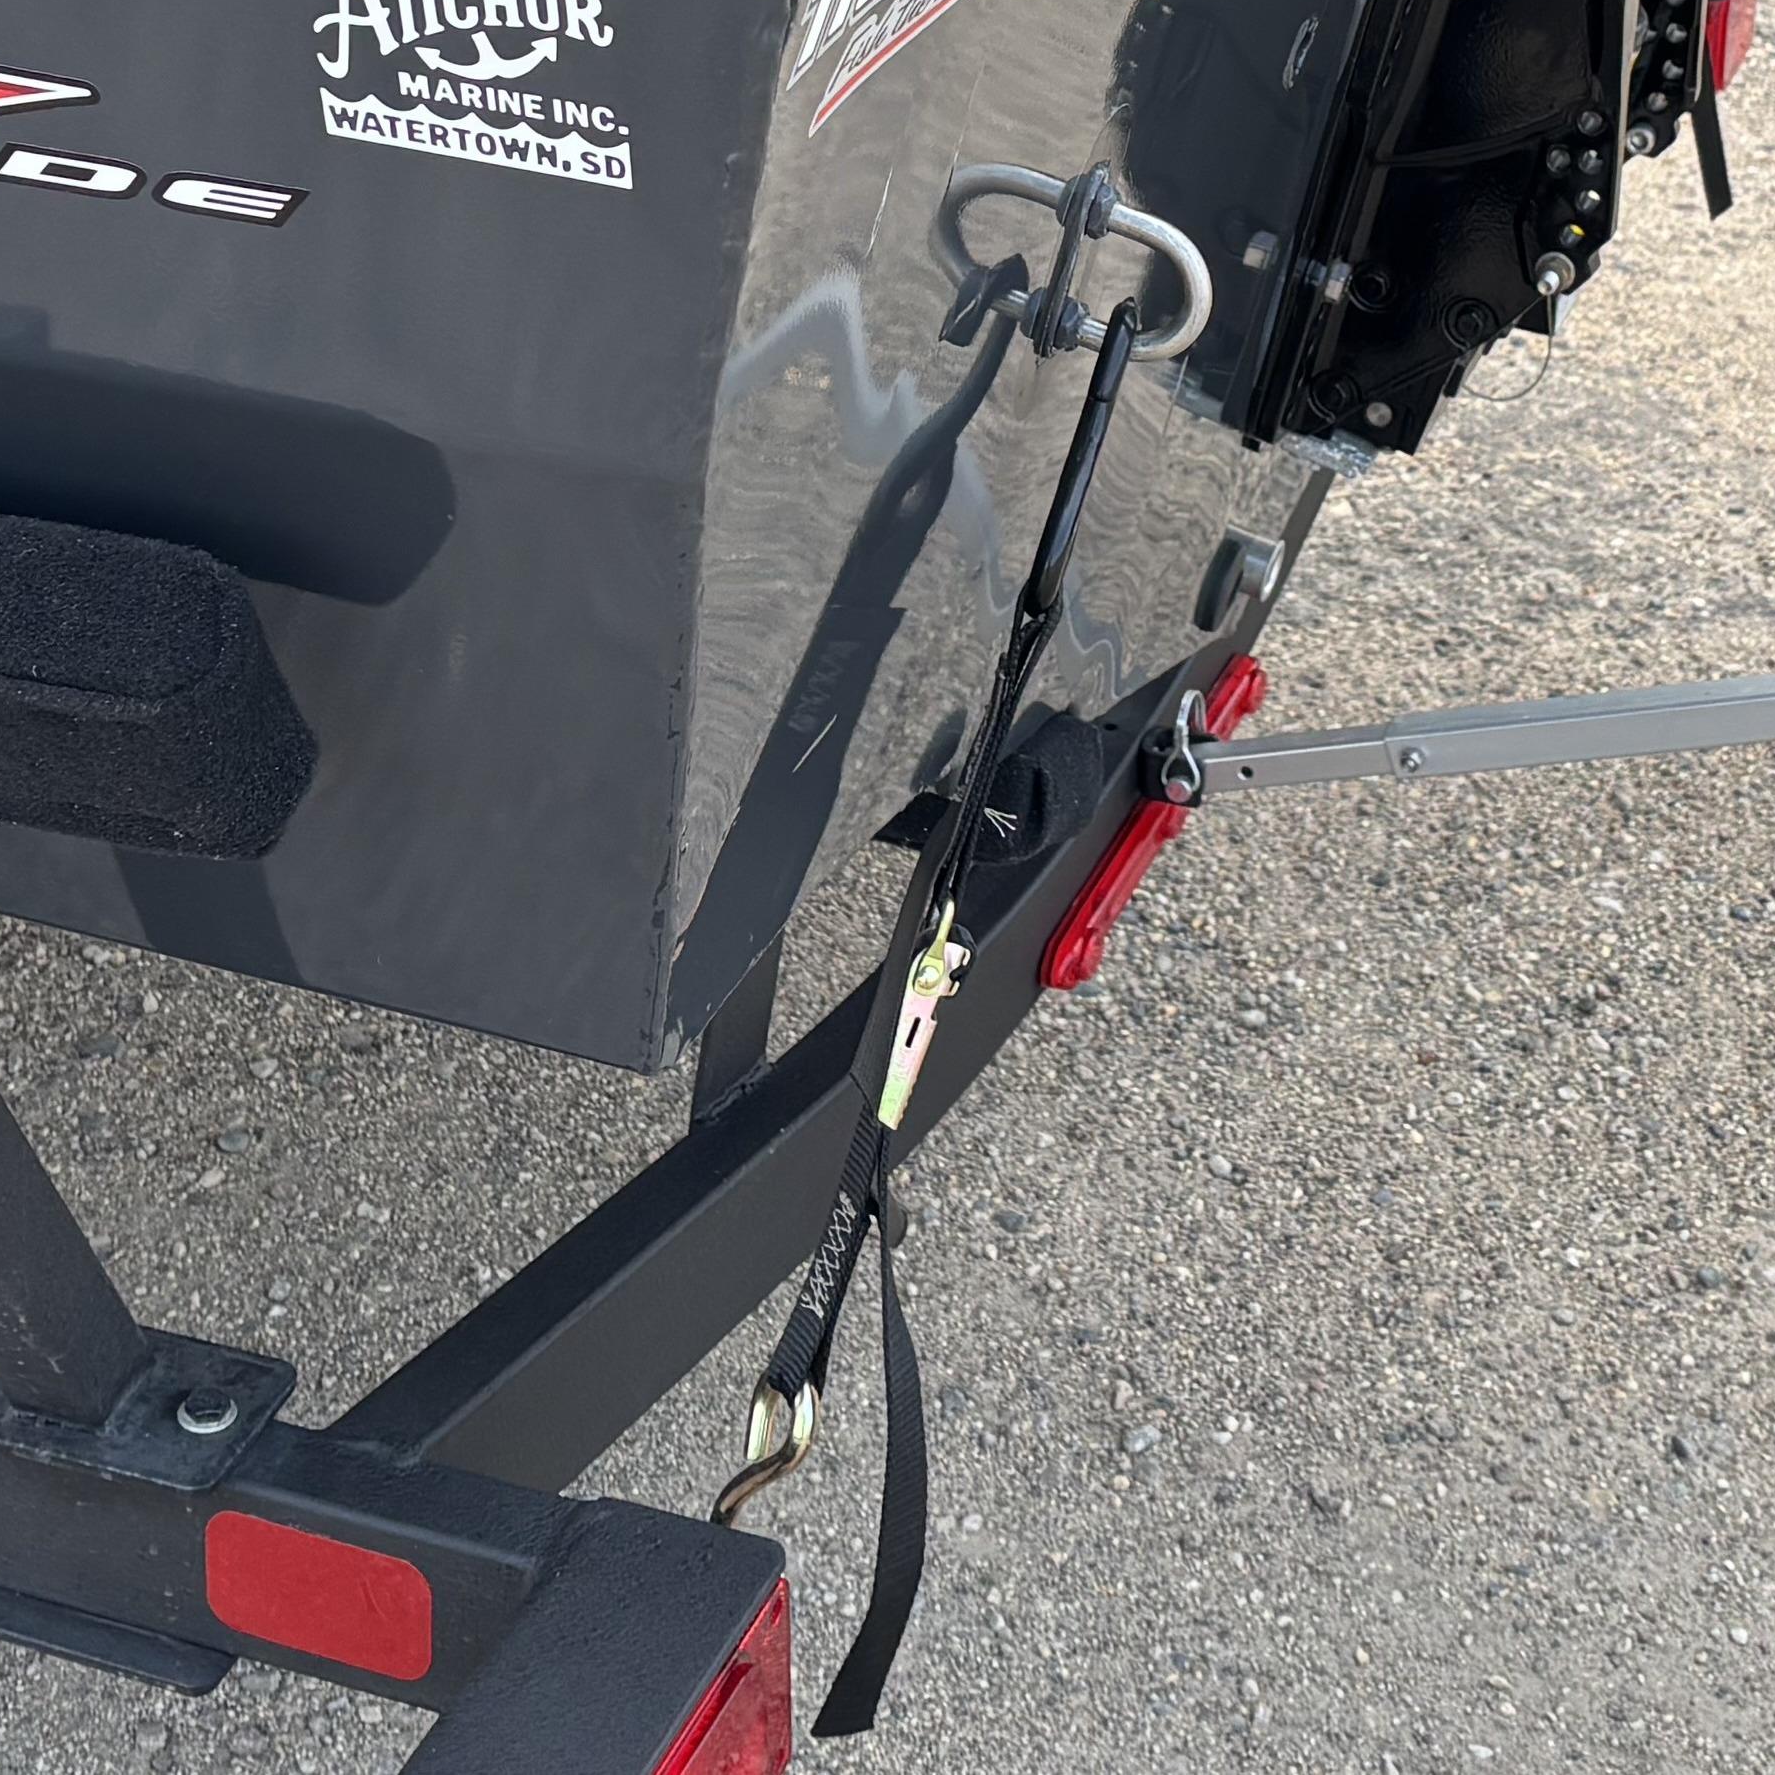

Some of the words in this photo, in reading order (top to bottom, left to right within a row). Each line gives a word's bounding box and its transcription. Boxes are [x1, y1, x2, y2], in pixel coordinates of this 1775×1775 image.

[397, 70, 546, 121] MARINE
[552, 98, 631, 137] INC.
[580, 151, 627, 180] SD
